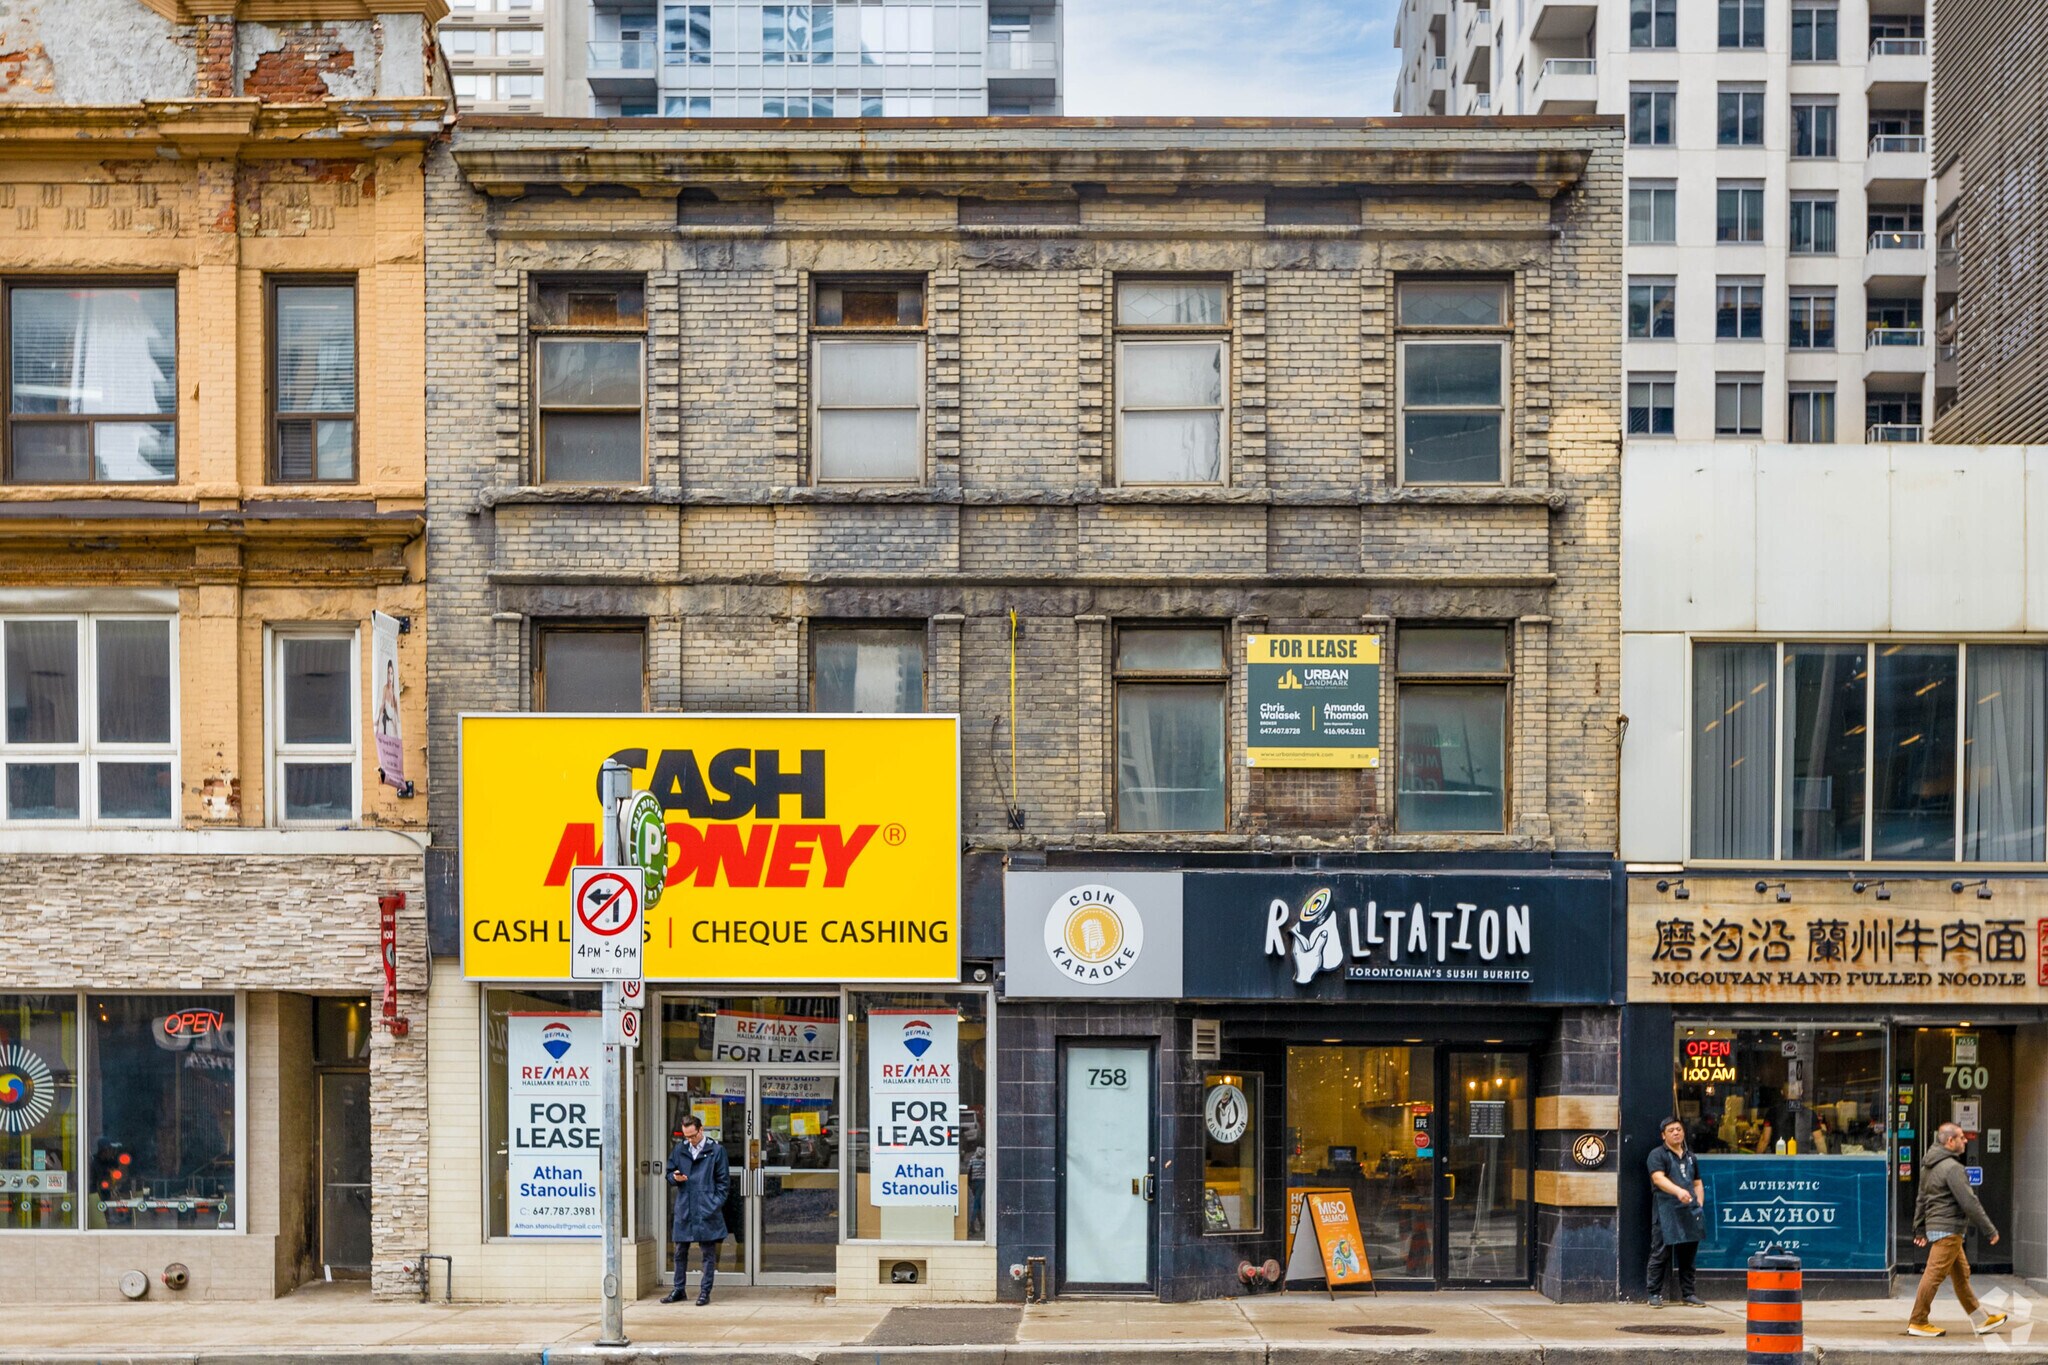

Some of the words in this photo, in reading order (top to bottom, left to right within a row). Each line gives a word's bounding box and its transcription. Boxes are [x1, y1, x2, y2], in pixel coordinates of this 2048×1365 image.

[1269, 639, 1302, 658] FOR
[1307, 639, 1358, 658] LEASE
[1304, 669, 1349, 680] URBAN
[1260, 703, 1285, 712] Chris
[1324, 703, 1366, 712] Amanda
[1260, 711, 1301, 720] Walasek
[1324, 711, 1369, 720] Thomson
[1069, 890, 1115, 906] COIN
[473, 919, 548, 943] CASH
[692, 920, 808, 946] CHEQUE
[820, 920, 949, 944] CASHING
[577, 944, 601, 958] 4PM
[614, 945, 637, 958] 6PM
[1052, 947, 1135, 979] KARAOKE
[1349, 967, 1442, 979] TORONTONIAN'S
[1446, 969, 1478, 979] SUSHI
[1482, 970, 1531, 980] BURRITO
[1652, 971, 1772, 986] MOGOUYAN
[1777, 971, 1842, 986] HAND
[1847, 972, 1932, 987] PULLED
[1938, 972, 2026, 987] NOODLE
[164, 1012, 224, 1034] OPEN
[737, 1021, 798, 1036] RE/MAX
[1687, 1041, 1730, 1056] OPEN
[1958, 1038, 1975, 1046] PASS
[717, 1044, 761, 1062] FOR
[768, 1048, 833, 1062] LEASE
[1691, 1056, 1725, 1067] TILL
[522, 1066, 590, 1080] RE/MAX
[883, 1064, 950, 1078] RE/MAX
[1088, 1068, 1127, 1086] 758
[1683, 1067, 1710, 1081] 1:00
[1711, 1067, 1736, 1081] AM
[1943, 1066, 1989, 1090] 760
[530, 1102, 587, 1124] FOR
[891, 1101, 948, 1122] FOR
[516, 1127, 601, 1149] LEASE
[877, 1125, 959, 1147] LEASE
[533, 1165, 583, 1180] Athan
[895, 1163, 945, 1178] Athan
[520, 1183, 597, 1198] Stanoulis
[881, 1180, 959, 1196] Stanoulis
[1739, 1181, 1820, 1191] AUTHENTIC
[532, 1207, 596, 1216] 647.787.3981
[1318, 1200, 1346, 1215] MISO
[1321, 1213, 1349, 1223] SALMON
[1723, 1208, 1836, 1223] LANZHOU
[1758, 1240, 1800, 1249] TASTE
